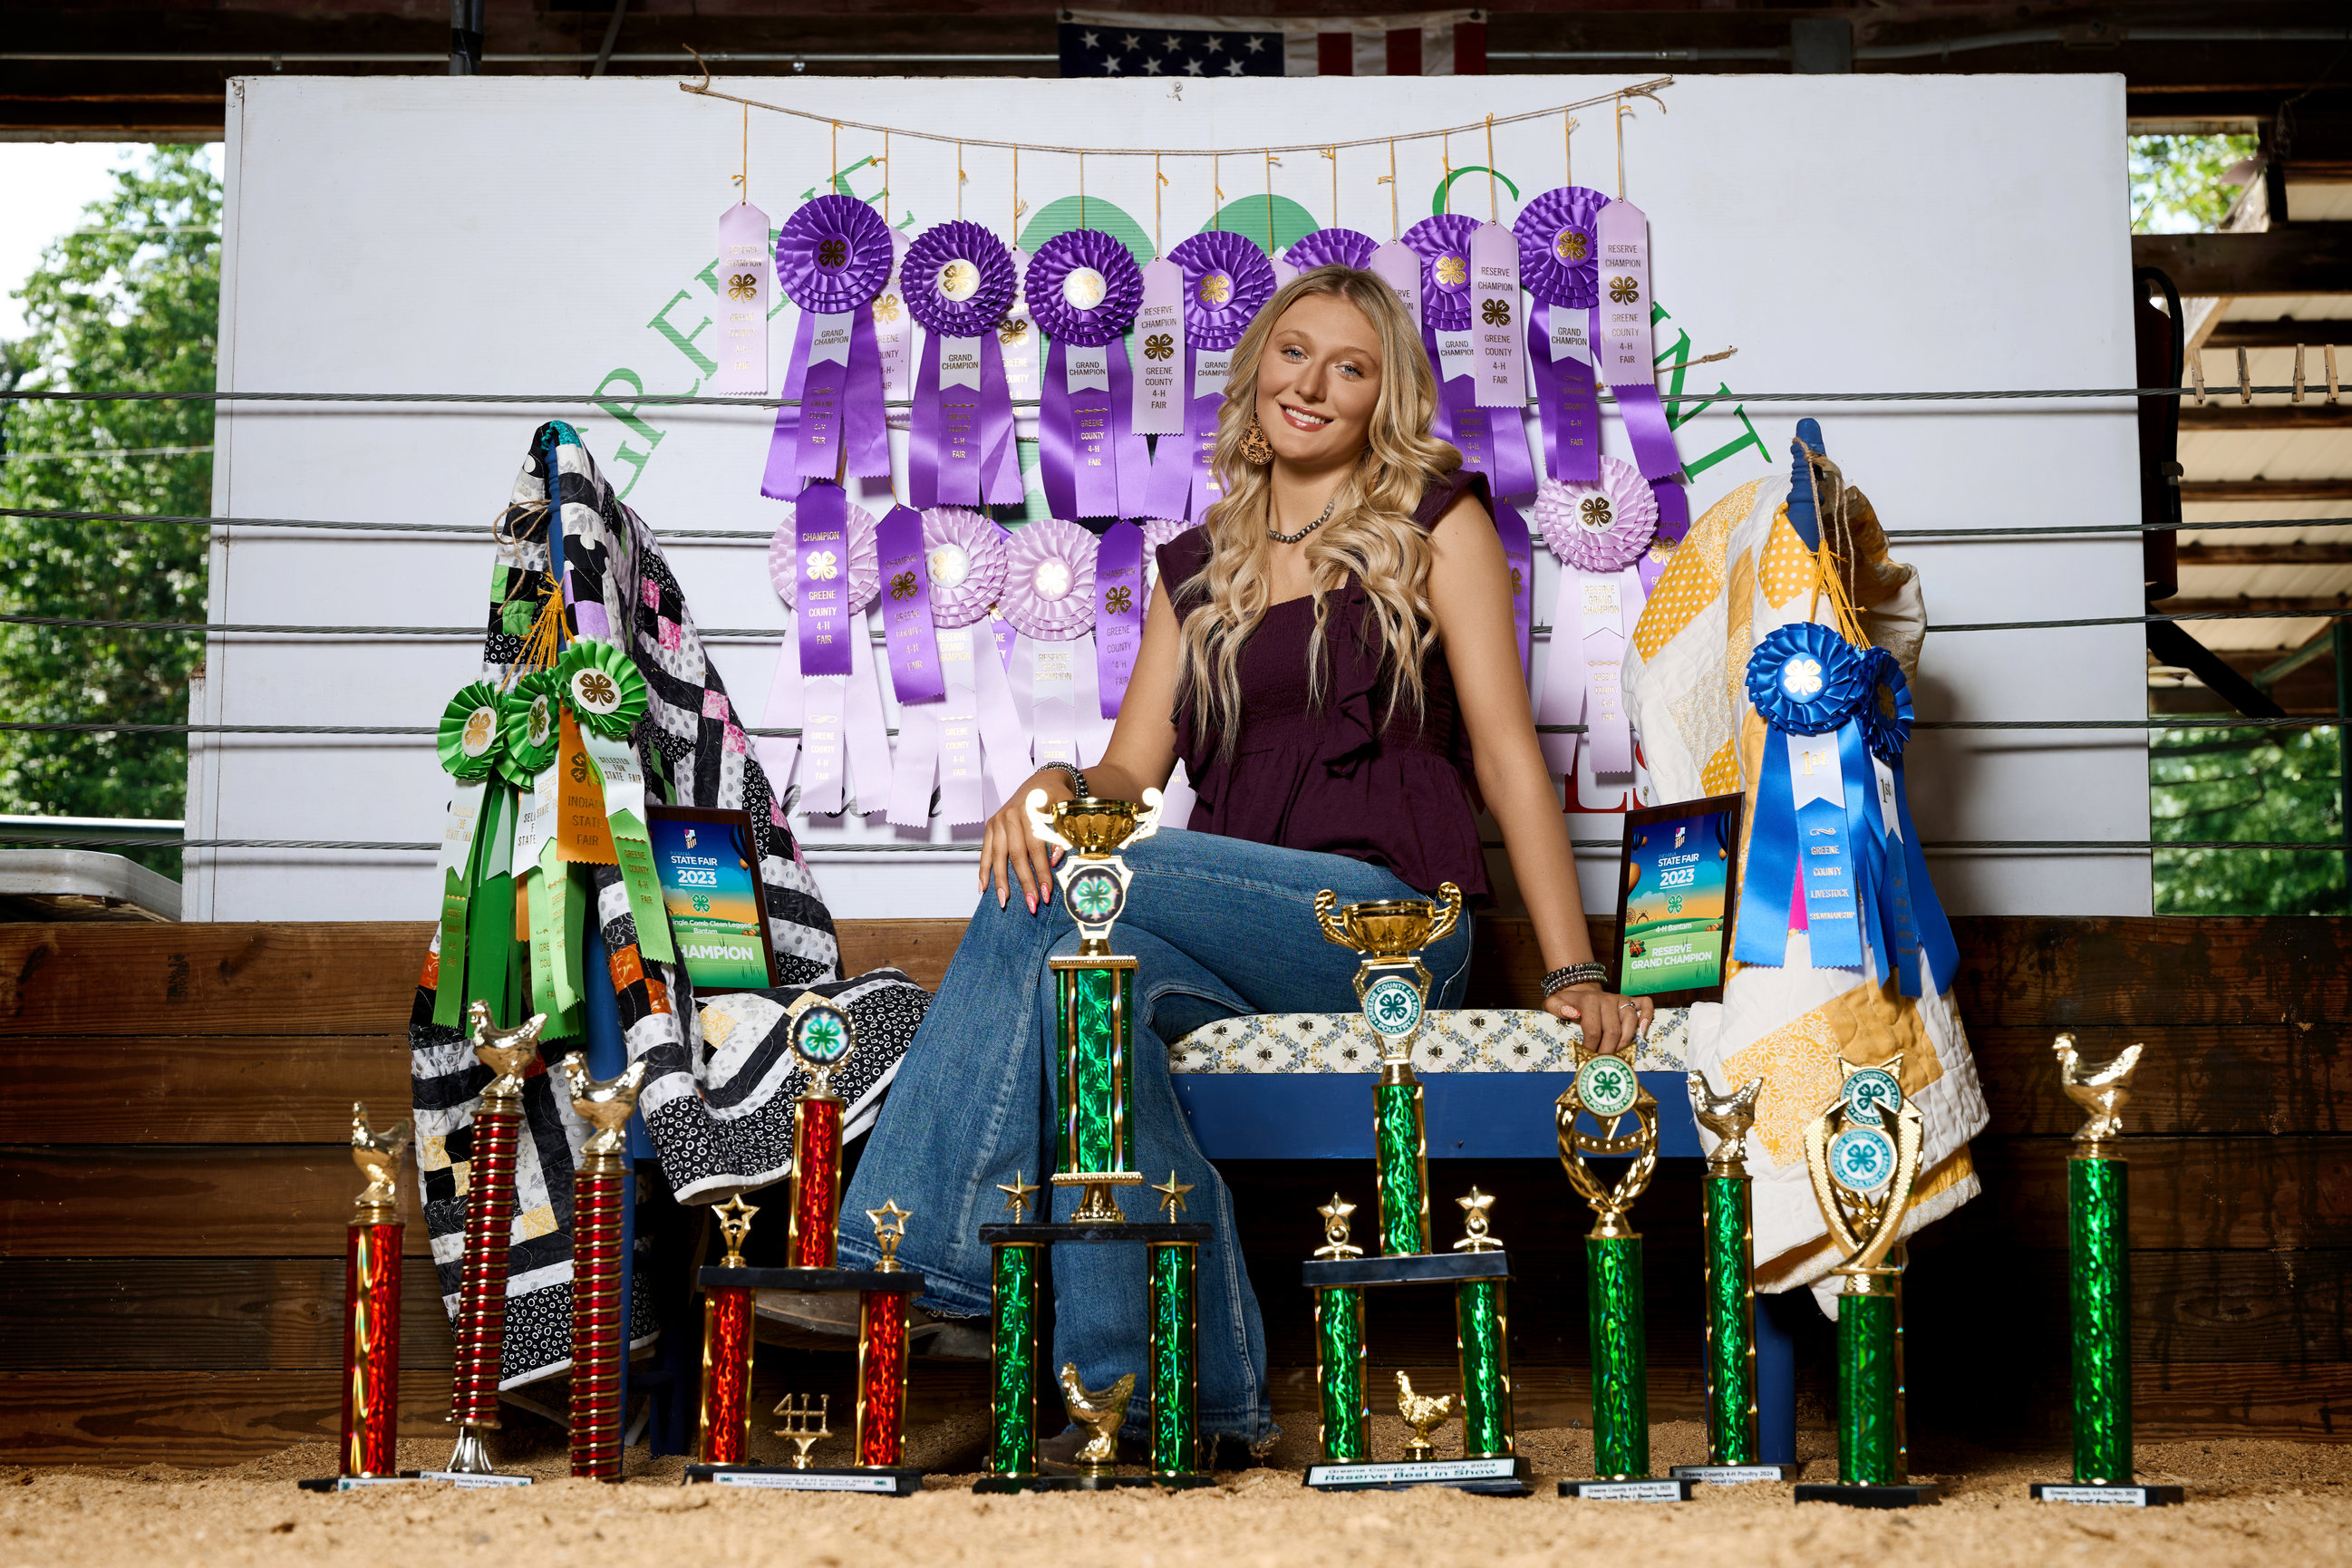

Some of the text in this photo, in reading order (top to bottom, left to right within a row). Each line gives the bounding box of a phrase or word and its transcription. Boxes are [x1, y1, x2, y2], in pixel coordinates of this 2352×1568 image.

[729, 246, 759, 254] RESERVE
[1608, 245, 1637, 253] RESERVE
[726, 259, 761, 267] CHAMPION
[1605, 259, 1641, 267] CHAMPION
[1481, 266, 1510, 276] RESERVE
[1478, 282, 1513, 291] CHAMPION
[1145, 305, 1173, 316] RESERVE
[730, 313, 754, 321] GREENE
[1612, 314, 1638, 322] GREENE
[1141, 318, 1176, 328] CHAMPION
[1558, 327, 1581, 335] GRAND
[814, 336, 848, 346] CHAMPION
[1485, 334, 1511, 343] GREENE
[1552, 336, 1587, 345] CHAMPION
[1486, 348, 1512, 356] COUNTY
[735, 362, 750, 370] FAIR
[942, 362, 979, 370] CHAMPION
[1493, 376, 1507, 384] FAIR
[953, 450, 965, 459] FAIR
[803, 531, 839, 541] CHAMPION
[885, 555, 918, 569] CHAMPION
[1101, 567, 1135, 580] CHAMPION
[1585, 586, 1615, 594] RESERVE
[808, 591, 836, 600] GREENE
[808, 607, 837, 616] COUNTY
[895, 610, 920, 622] GREENE
[817, 622, 829, 630] 4-H
[1107, 625, 1130, 636] GREENE
[896, 627, 923, 638] COUNTY
[817, 635, 832, 644] FAIR
[1107, 643, 1131, 653] COUNTY
[939, 653, 971, 662] HAMPION
[907, 661, 922, 670] FAIR
[1035, 673, 1071, 681] CHAMPION
[1116, 677, 1128, 685] FAIR
[811, 732, 834, 740] GREENE
[599, 757, 630, 765] SELECTED
[1801, 749, 1828, 775] 1st
[605, 770, 642, 784] STATE FAIR
[1881, 779, 1891, 803] 1st
[573, 816, 604, 828] STATE
[446, 830, 460, 840] STATE
[577, 835, 598, 846] FAIR
[624, 850, 646, 859] GREENE
[1811, 846, 1839, 855] GREENE
[671, 857, 718, 866] STATE FAIR
[1659, 854, 1699, 866] STATE FAIR
[628, 865, 649, 874] COUNTY
[1814, 867, 1842, 876] COUNTY
[678, 870, 716, 885] 2023
[1660, 868, 1695, 886] 2023
[638, 880, 648, 889] 4-H
[1811, 889, 1849, 898] LIVESTOCK
[641, 895, 653, 905] FAIR
[1810, 912, 1854, 920] SHOWMANSHIP
[681, 944, 753, 960] HAMPION
[1652, 944, 1691, 956] RESERVE
[1631, 952, 1712, 969] GRAND CHAMPION
[1368, 991, 1378, 1021] GREENE
[1377, 982, 1407, 992] COUNTY
[1407, 990, 1416, 1001] 4-H
[1378, 1021, 1411, 1032] POULTRY
[1581, 1067, 1592, 1096] GREENE
[1592, 1060, 1622, 1070] COUNTY
[1589, 1099, 1624, 1112] POULTRY
[1325, 1473, 1388, 1481] Reserve
